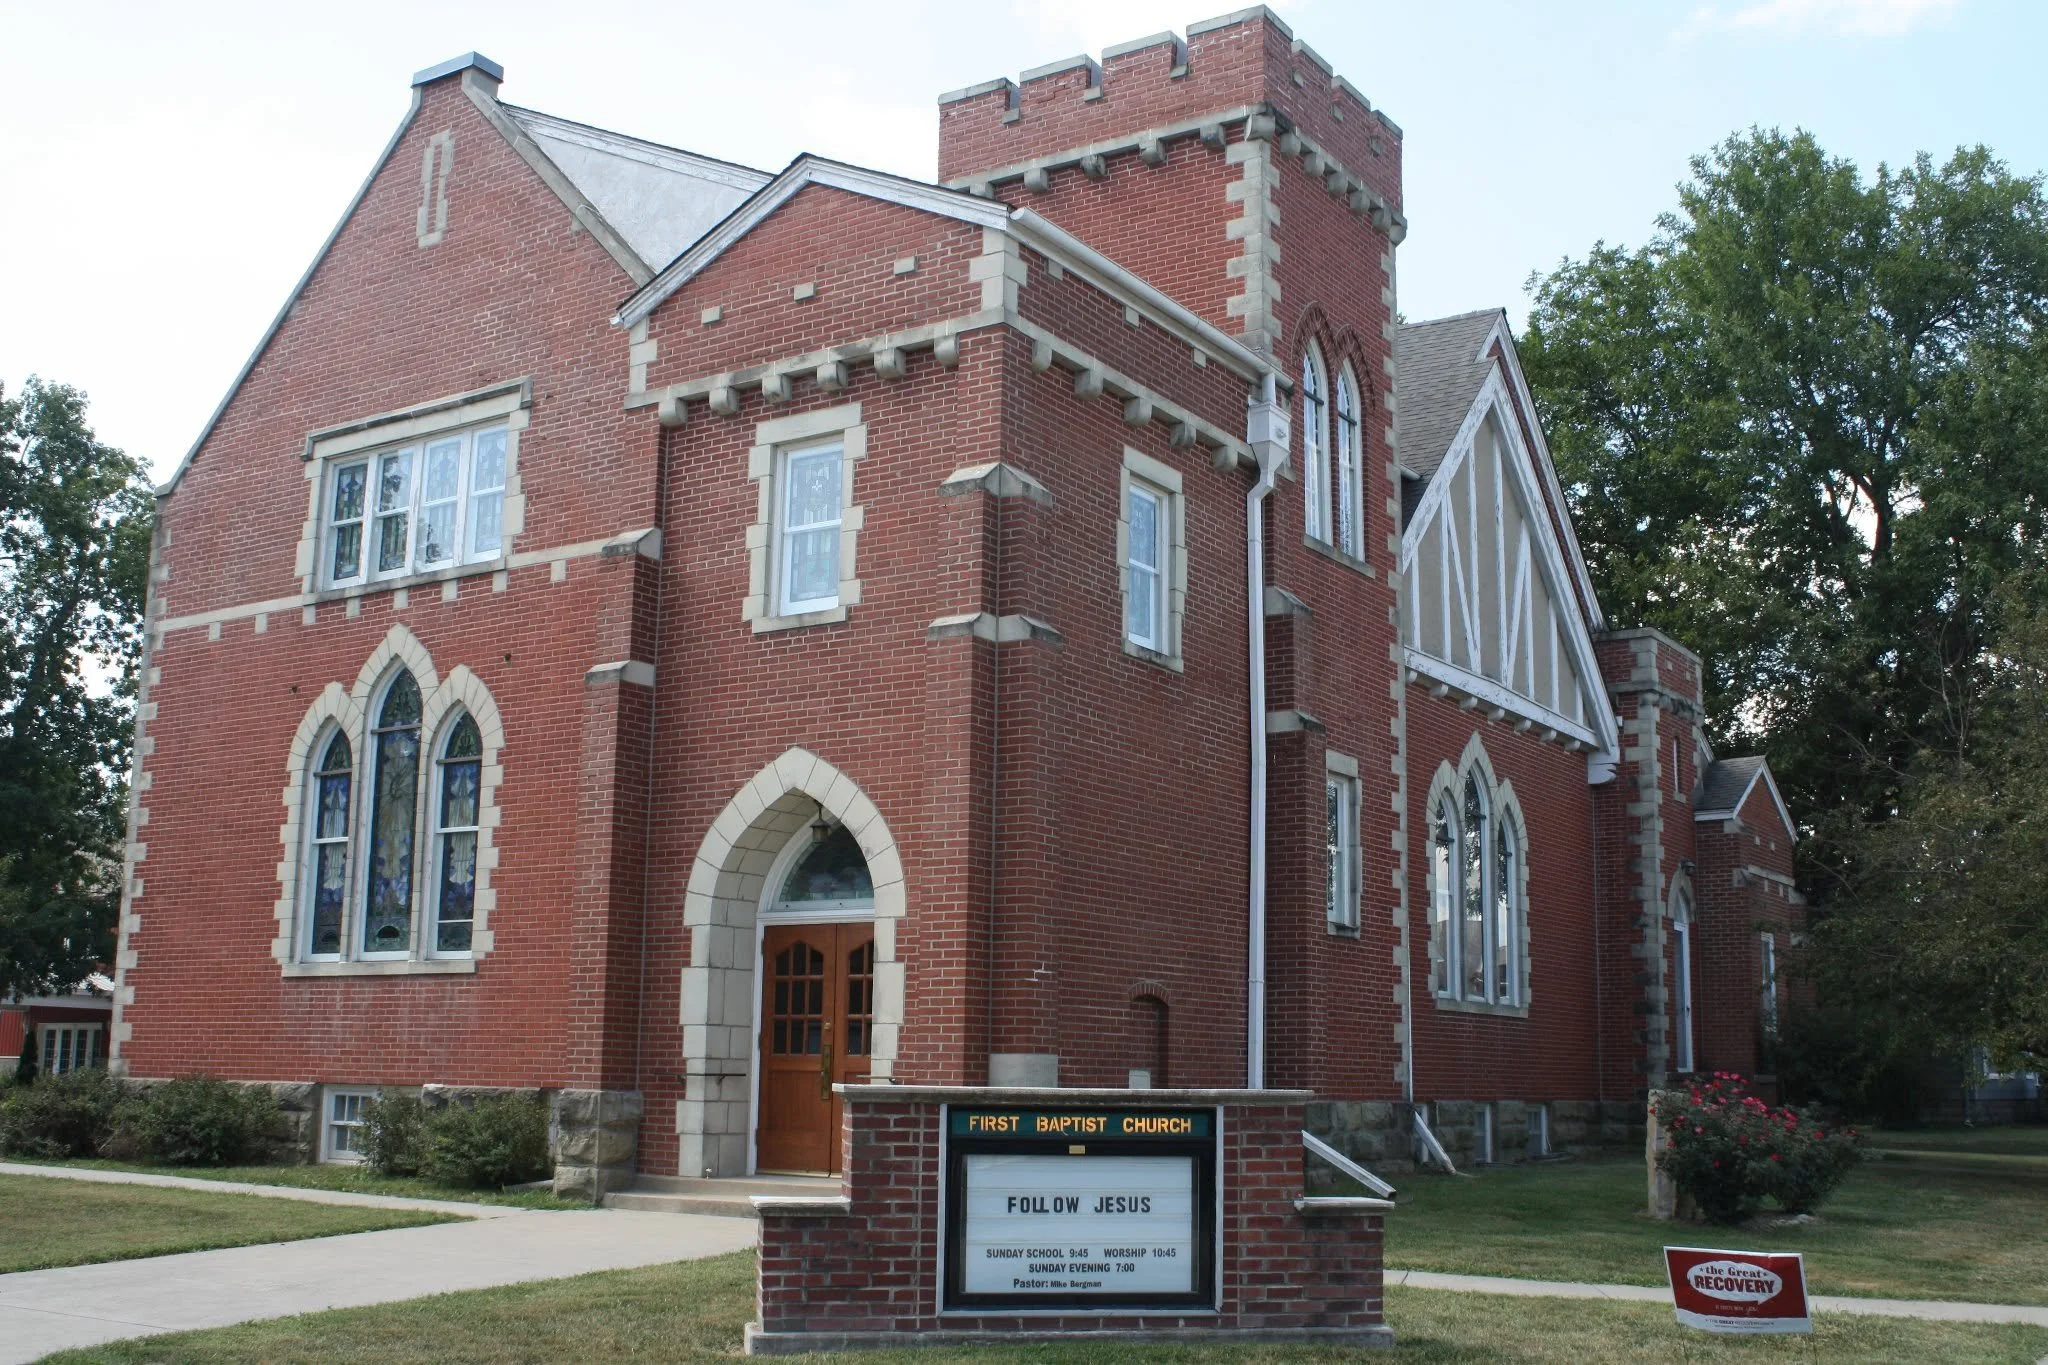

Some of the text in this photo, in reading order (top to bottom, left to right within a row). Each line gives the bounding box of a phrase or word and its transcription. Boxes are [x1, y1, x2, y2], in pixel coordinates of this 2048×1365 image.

[969, 1116, 1192, 1133] FIRST BAPTIST CHURCH
[1007, 1196, 1151, 1213] FOLLOW JESUS
[986, 1248, 1176, 1258] SUNDAY SCHOOL 9:45 WORSHIP 10:45
[1028, 1263, 1135, 1273] SUNDAY EVENING 7:00
[1705, 1265, 1761, 1278] the Great
[1013, 1278, 1102, 1289] Pastor: Mike Bergman
[1694, 1275, 1775, 1293] RECOVERY
